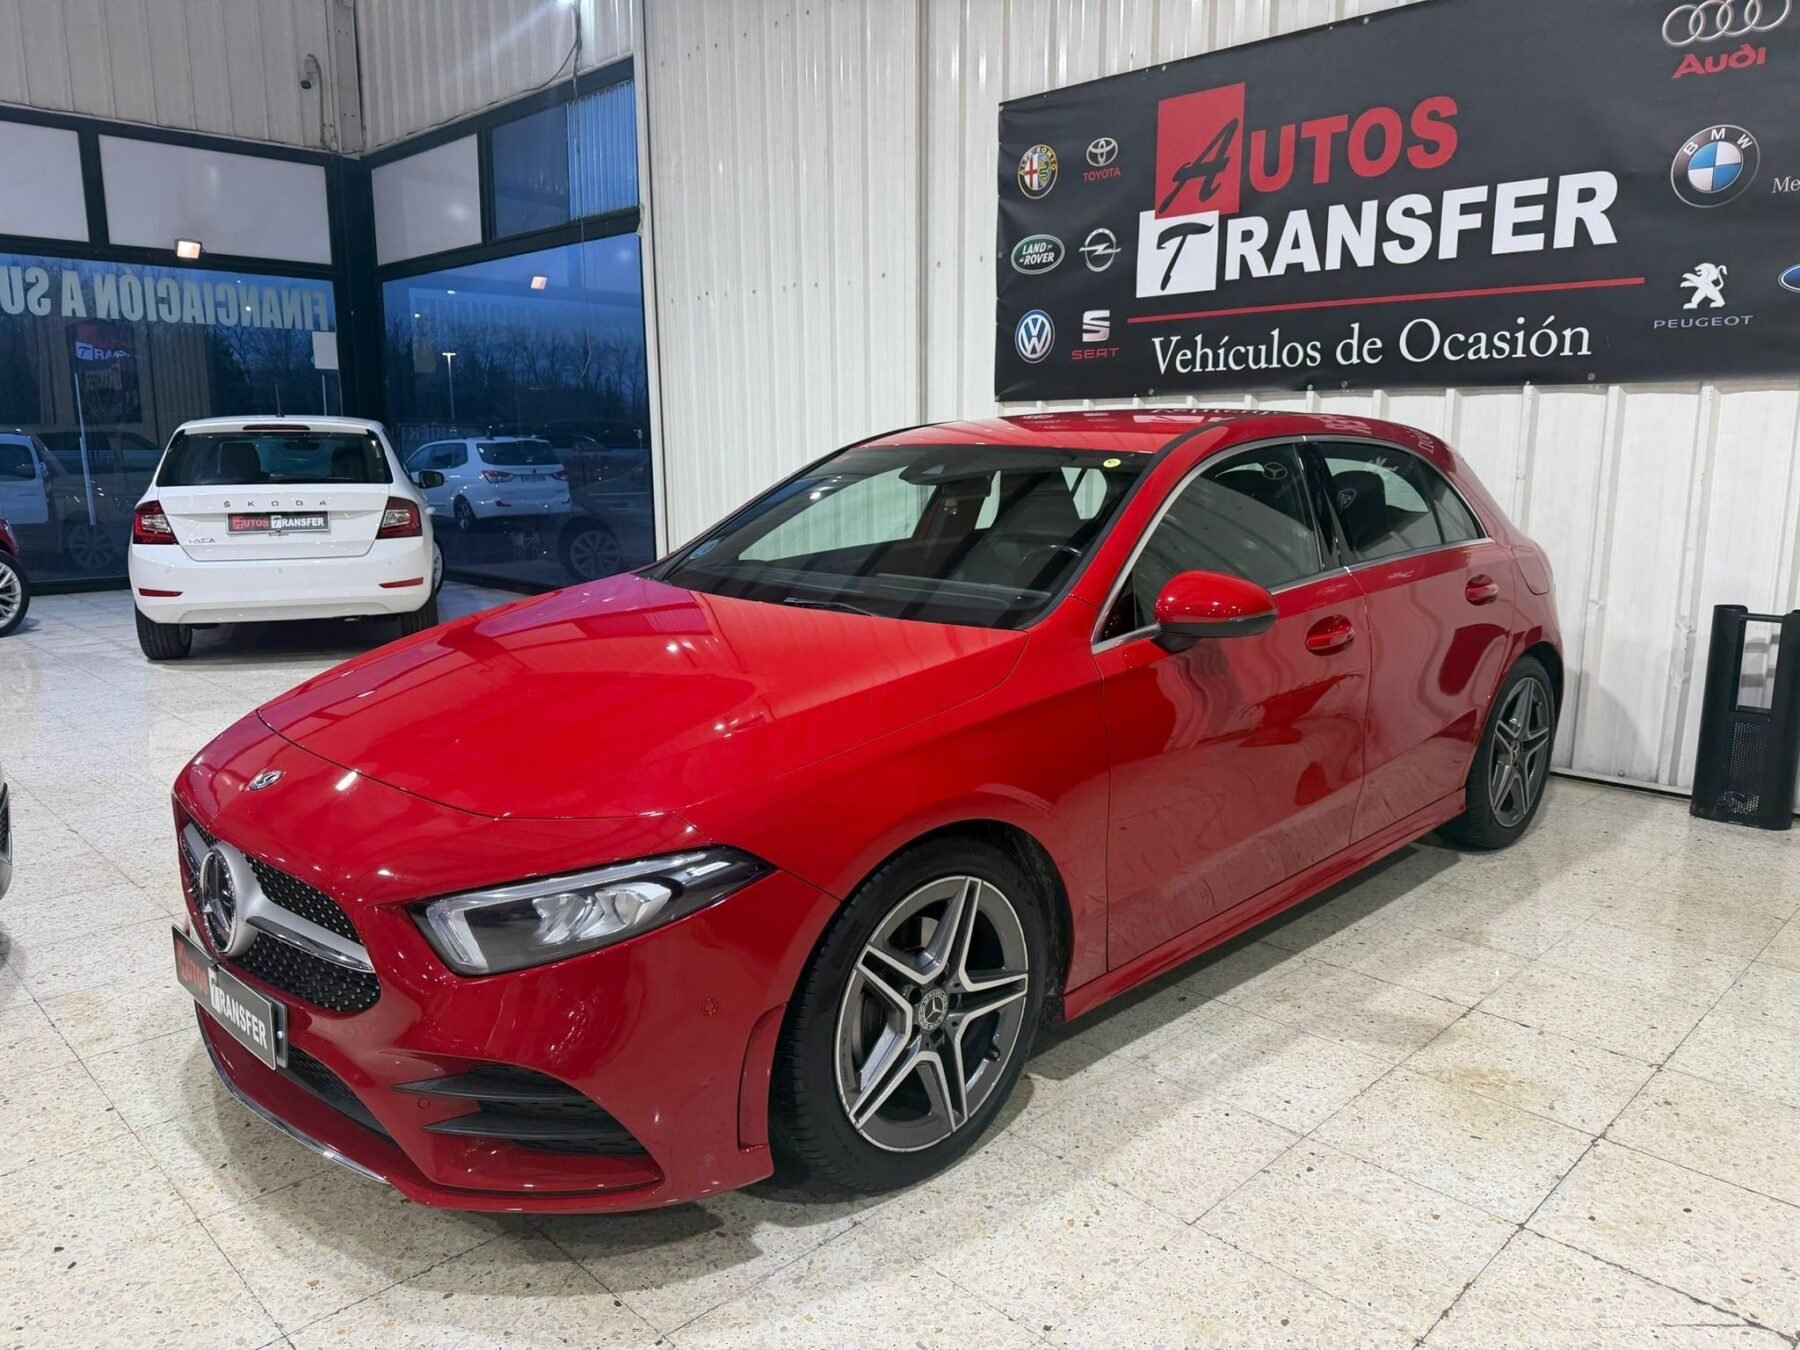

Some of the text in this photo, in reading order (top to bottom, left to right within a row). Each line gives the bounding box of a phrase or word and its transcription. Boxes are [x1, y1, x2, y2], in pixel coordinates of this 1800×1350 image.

[1672, 43, 1768, 80] Audi
[1683, 127, 1753, 156] BMW
[1158, 96, 1458, 214] AUTOS
[1082, 167, 1121, 182] TOYOTA
[1156, 170, 1618, 291] TRANSFER
[1022, 242, 1046, 256] LAND
[1023, 252, 1055, 266] ROVER
[1653, 316, 1754, 329] PEUGEOT
[1071, 347, 1120, 361] SEAT
[1152, 315, 1592, 375] Vehículos de Ocasión
[271, 515, 324, 529] TRANSFER
[208, 967, 268, 1051] TRANSFER
